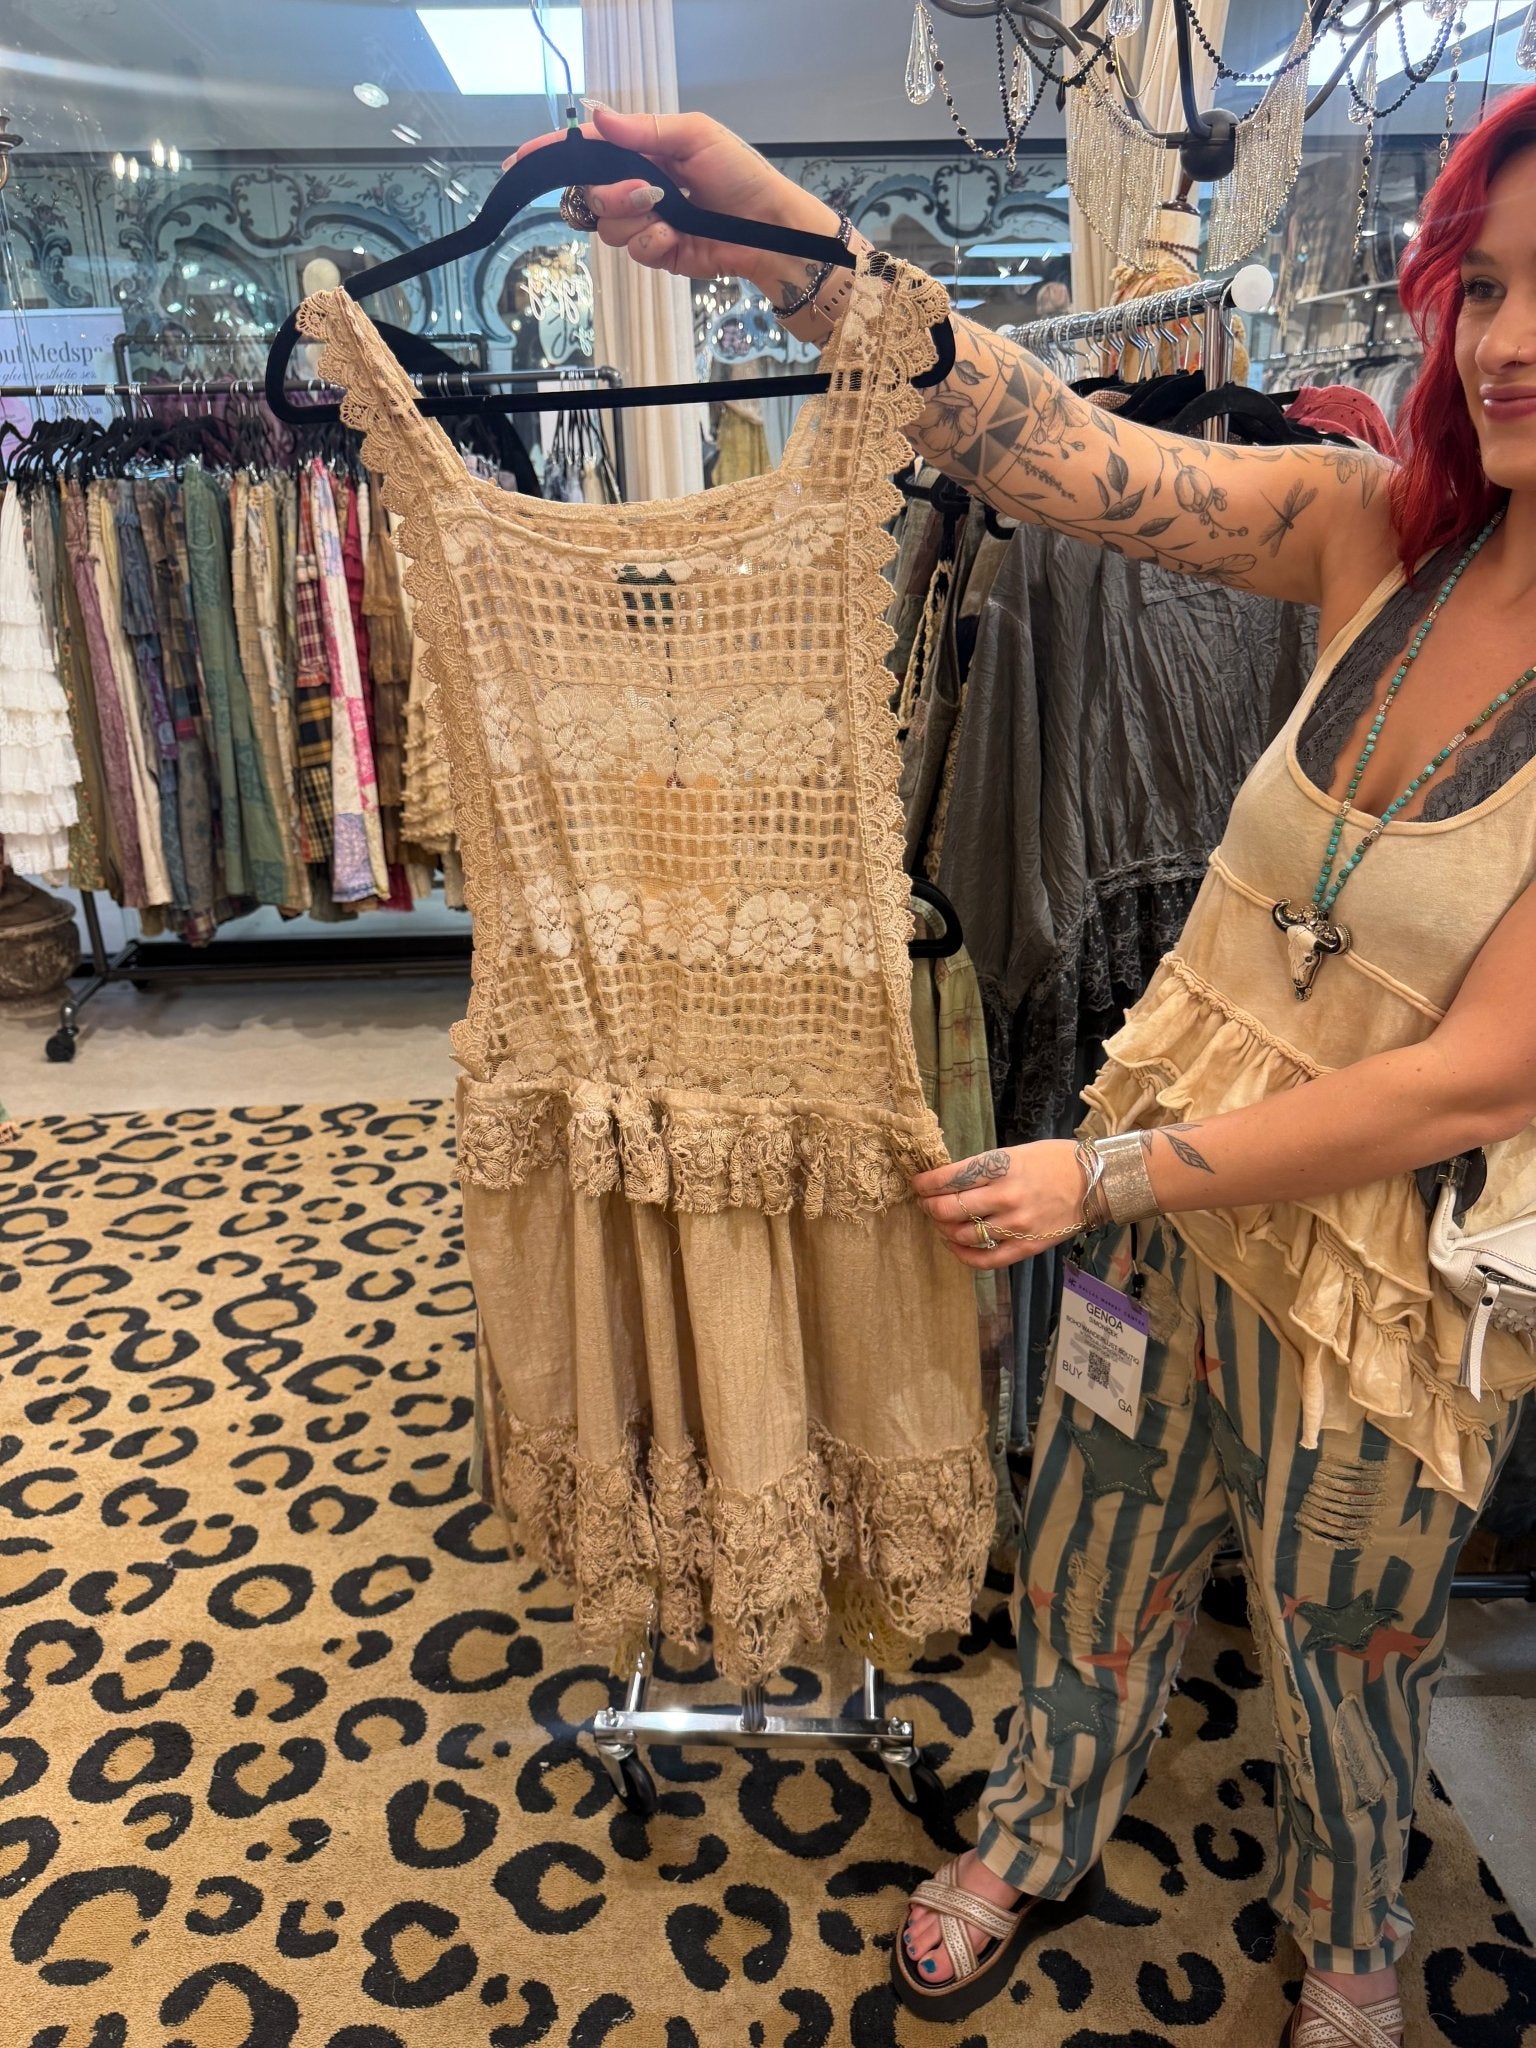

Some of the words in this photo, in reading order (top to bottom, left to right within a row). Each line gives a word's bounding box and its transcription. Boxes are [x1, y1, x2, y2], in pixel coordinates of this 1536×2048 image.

[1086, 1302, 1124, 1333] GENOA
[1062, 1360, 1083, 1379] BUY
[1118, 1398, 1133, 1416] GA
